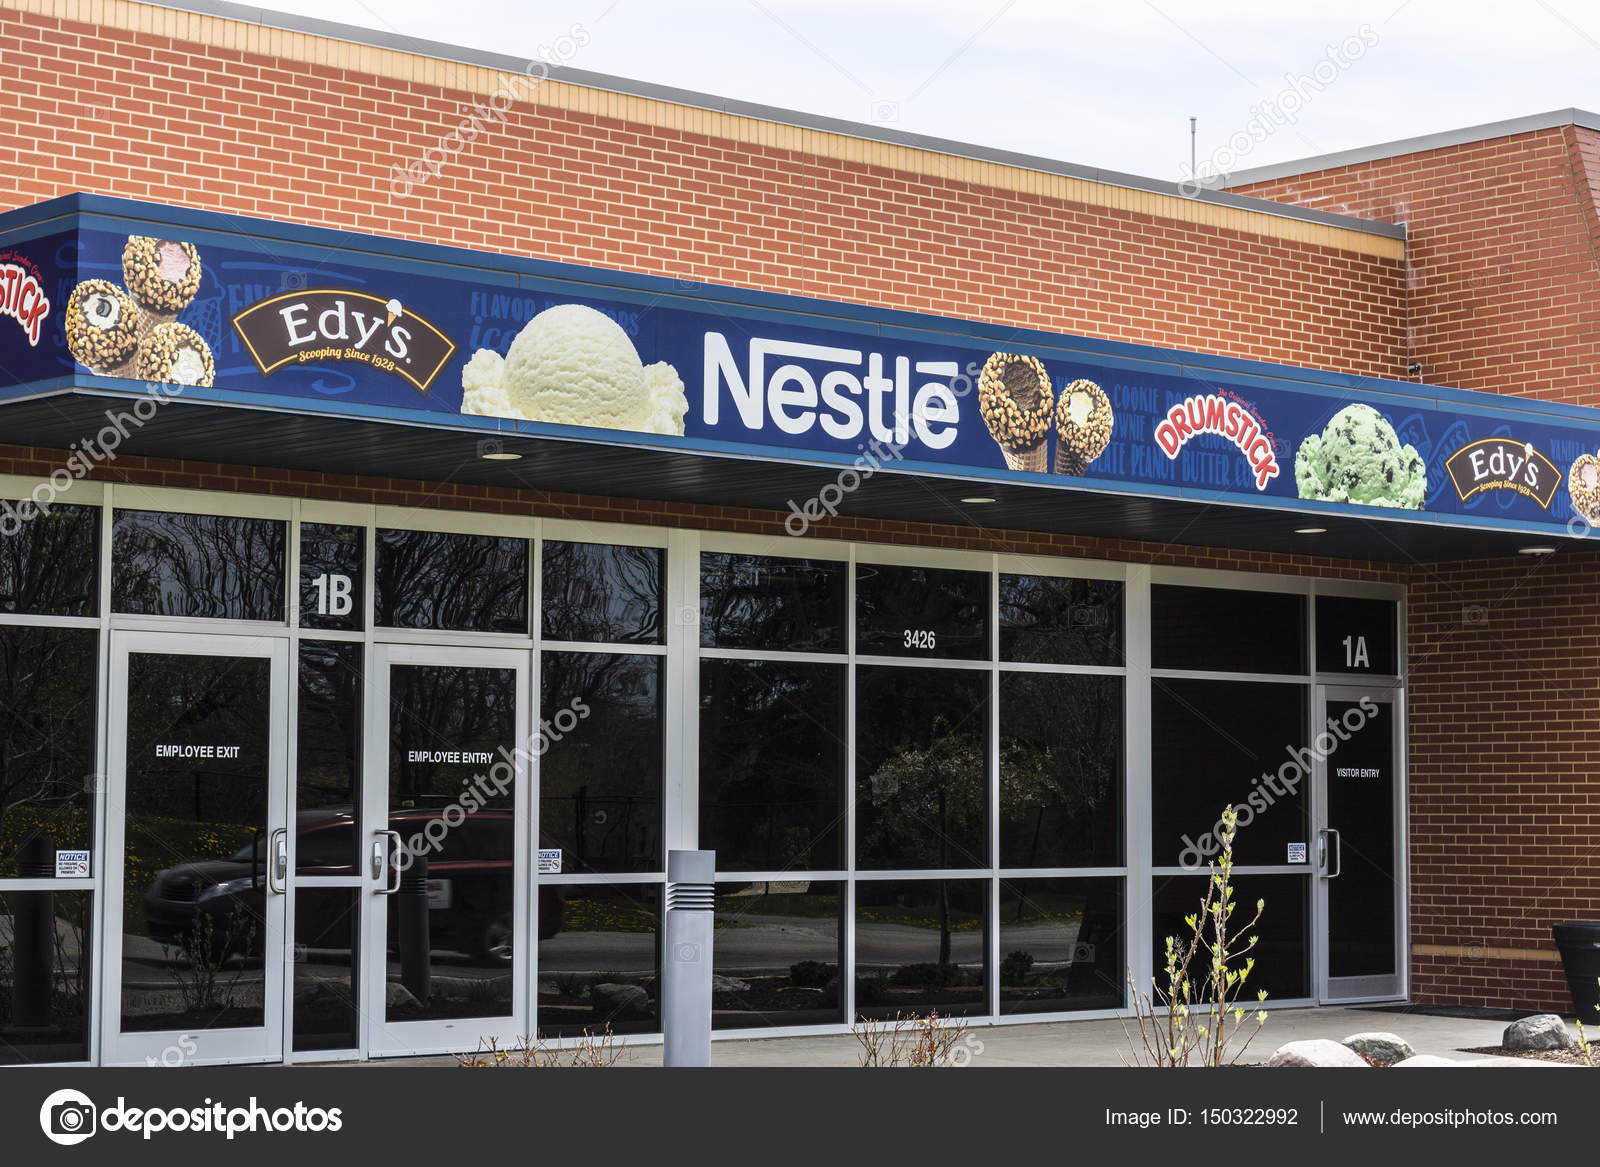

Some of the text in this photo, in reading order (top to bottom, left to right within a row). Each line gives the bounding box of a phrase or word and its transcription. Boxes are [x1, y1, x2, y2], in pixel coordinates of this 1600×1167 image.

[299, 346, 396, 371] Scooping Since 1928
[1155, 395, 1279, 490] DRUMSTICK
[312, 573, 353, 616] 1B
[903, 629, 936, 650] 3426
[1342, 635, 1370, 668] 1A
[155, 744, 240, 759] EMPLOYEE EXIT
[408, 750, 494, 766] EMPLOYEE ENTRY
[1336, 768, 1380, 778] VISITOR ENTRY
[59, 852, 87, 861] NOTICE
